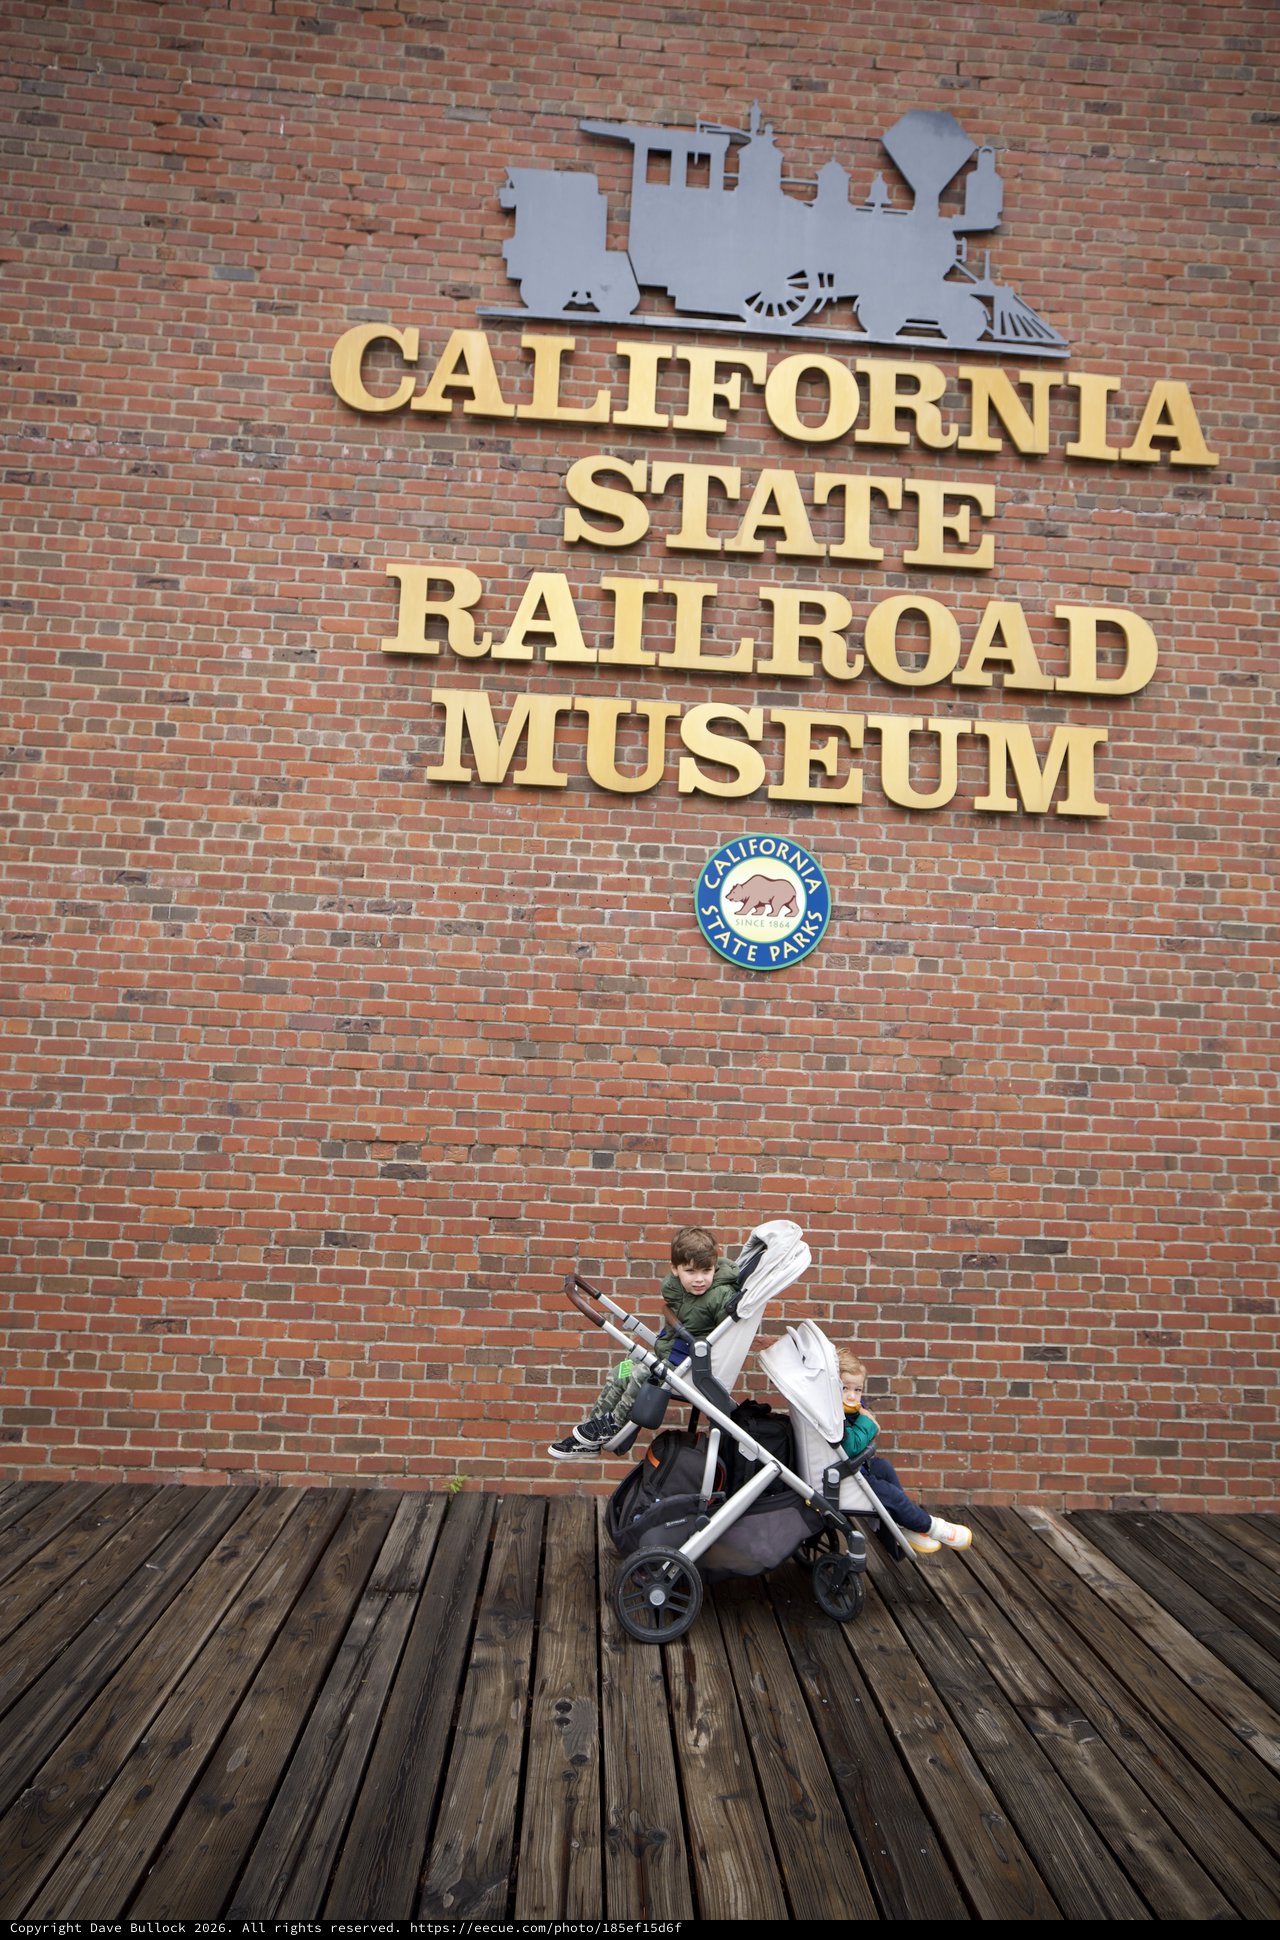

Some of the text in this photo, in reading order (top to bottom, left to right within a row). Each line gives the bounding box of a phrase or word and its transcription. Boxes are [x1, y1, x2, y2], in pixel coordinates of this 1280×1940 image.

[330, 322, 1220, 467] CALIFORNIA
[563, 455, 996, 570] STATE
[380, 563, 1159, 696] RAILROAD
[425, 688, 1110, 818] MUSEUM
[704, 838, 823, 895] CALIFORNIA
[735, 918, 791, 929] SINCE 1864
[701, 905, 823, 962] STATE PARKS
